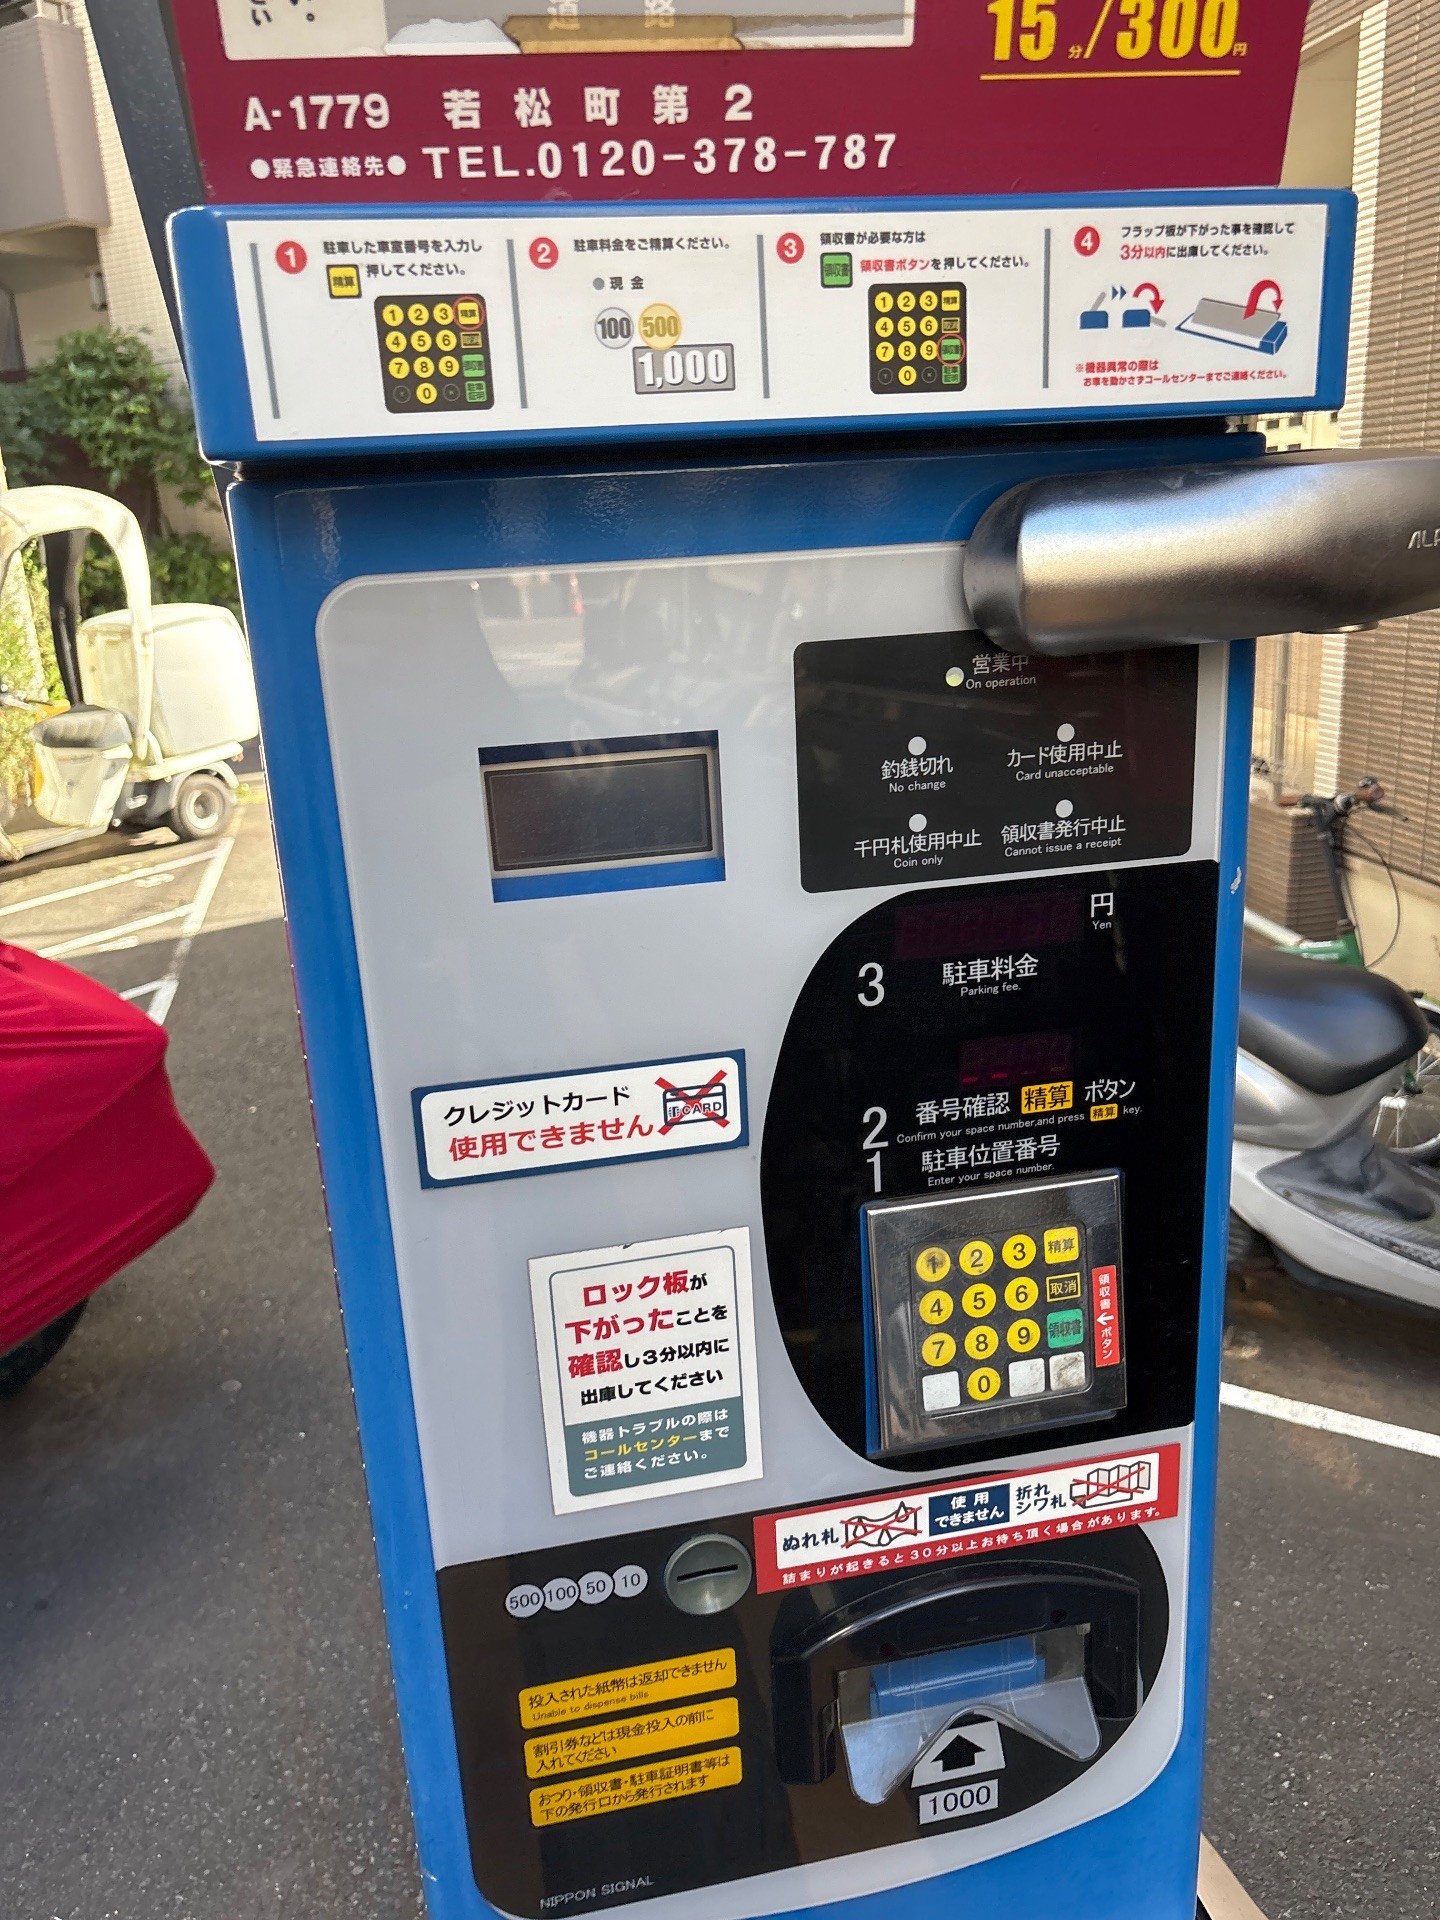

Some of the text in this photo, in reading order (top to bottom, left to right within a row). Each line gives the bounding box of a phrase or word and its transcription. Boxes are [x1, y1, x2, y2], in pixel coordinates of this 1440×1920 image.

[820, 231, 926, 246] 領収書が必要な方は
[1121, 222, 1295, 238] フラップ板が下がった事を確認して
[323, 239, 482, 255] 駐車した車室番号を入力し
[574, 238, 730, 253] 駐車料金をご精算ください。
[1120, 244, 1269, 260] 3分以内に出庫してください。
[366, 263, 466, 278] 押してください。
[609, 276, 645, 290] 現金
[880, 295, 888, 308] 1
[902, 295, 911, 308] 2
[925, 295, 933, 307] 3
[389, 309, 397, 321] 1
[415, 308, 423, 321] 2
[440, 308, 449, 320] 3
[880, 321, 889, 333] 4
[902, 320, 911, 333] 5
[925, 319, 933, 332] 6
[597, 315, 680, 340] 100 500
[391, 335, 401, 348] 4
[417, 334, 426, 347] 5
[442, 333, 451, 347] 6
[881, 346, 889, 358] 7
[903, 345, 911, 358] 8
[925, 344, 934, 357] 9
[395, 362, 403, 375] 7
[420, 361, 429, 374] 8
[445, 360, 453, 373] 9
[638, 349, 728, 389] 1,000
[903, 369, 912, 382] 0
[1083, 369, 1288, 388] お車を動かさずコールセンターまでご連絡ください。
[422, 387, 431, 400] 0
[971, 653, 1030, 676] 営業中
[966, 673, 1037, 691] On operation
[1007, 739, 1124, 769] カード使用中止
[880, 755, 954, 781] 釣銭切れ
[1015, 762, 1115, 782] Card unacceptable
[889, 777, 947, 794] No change
[1000, 814, 1126, 845] 領収書発行中止
[853, 828, 983, 859] 千円札使用中止
[1004, 843, 1043, 857] Cannot
[1045, 841, 1073, 855] issue
[1085, 835, 1123, 852] receipt
[893, 853, 944, 869] Coin only
[1090, 892, 1114, 918] 円
[1092, 919, 1112, 930] Yen
[941, 952, 1039, 987] 駐車料金
[857, 961, 886, 1007] 3
[960, 981, 1022, 997] Parking fee.
[443, 1085, 631, 1128] クレジットカード
[681, 1100, 722, 1116] CARD
[862, 1078, 1136, 1151] 2 番号確認 精算 ボタン
[896, 1131, 937, 1144] Confirm
[939, 1127, 962, 1140] your
[965, 1123, 995, 1137] space
[1057, 1112, 1085, 1125] press
[1092, 1106, 1116, 1120] 精算
[1122, 1104, 1143, 1117] key.
[448, 1114, 655, 1162] 使用できません
[866, 1133, 1061, 1193] 1 駐車位置番号
[927, 1163, 1055, 1188] Enter your space number.
[970, 1249, 983, 1269] 2
[1012, 1243, 1026, 1262] 3
[1047, 1238, 1075, 1254] 精算
[582, 1269, 709, 1308] ロック板が
[929, 1280, 1077, 1318] 4 5 6 取消
[564, 1303, 729, 1345] 下がったことを
[1098, 1273, 1114, 1360] 領収書 ボタン
[931, 1320, 1083, 1360] 7 8 9 領収書
[567, 1337, 730, 1379] 確認し3分以内に
[580, 1368, 724, 1407] 出庫してください
[977, 1375, 991, 1394] 0
[581, 1407, 729, 1445] 機器トラブルの際は
[584, 1425, 730, 1462] コールセンターまで
[584, 1449, 709, 1480] ご連絡ください。
[950, 1491, 990, 1510] 使用
[1015, 1482, 1051, 1500] 折れ
[1016, 1494, 1067, 1515] シワ札
[933, 1507, 1005, 1529] できません
[782, 1527, 839, 1552] ぬれ札
[509, 1572, 642, 1611] 500 100 50 10
[528, 1657, 728, 1709] 投入された紙幣は返却できません
[532, 1690, 650, 1721] Unable to dispense bills
[532, 1708, 715, 1759] 割引券などは現金投入の前に
[536, 1745, 618, 1774] 入れてください
[538, 1754, 730, 1807] おつり・領収書・駐車証明書等は
[540, 1774, 710, 1822] 下の発行口から発行されます
[928, 1785, 991, 1816] 1000
[539, 1875, 656, 1911] NIPPON SIGNAL
